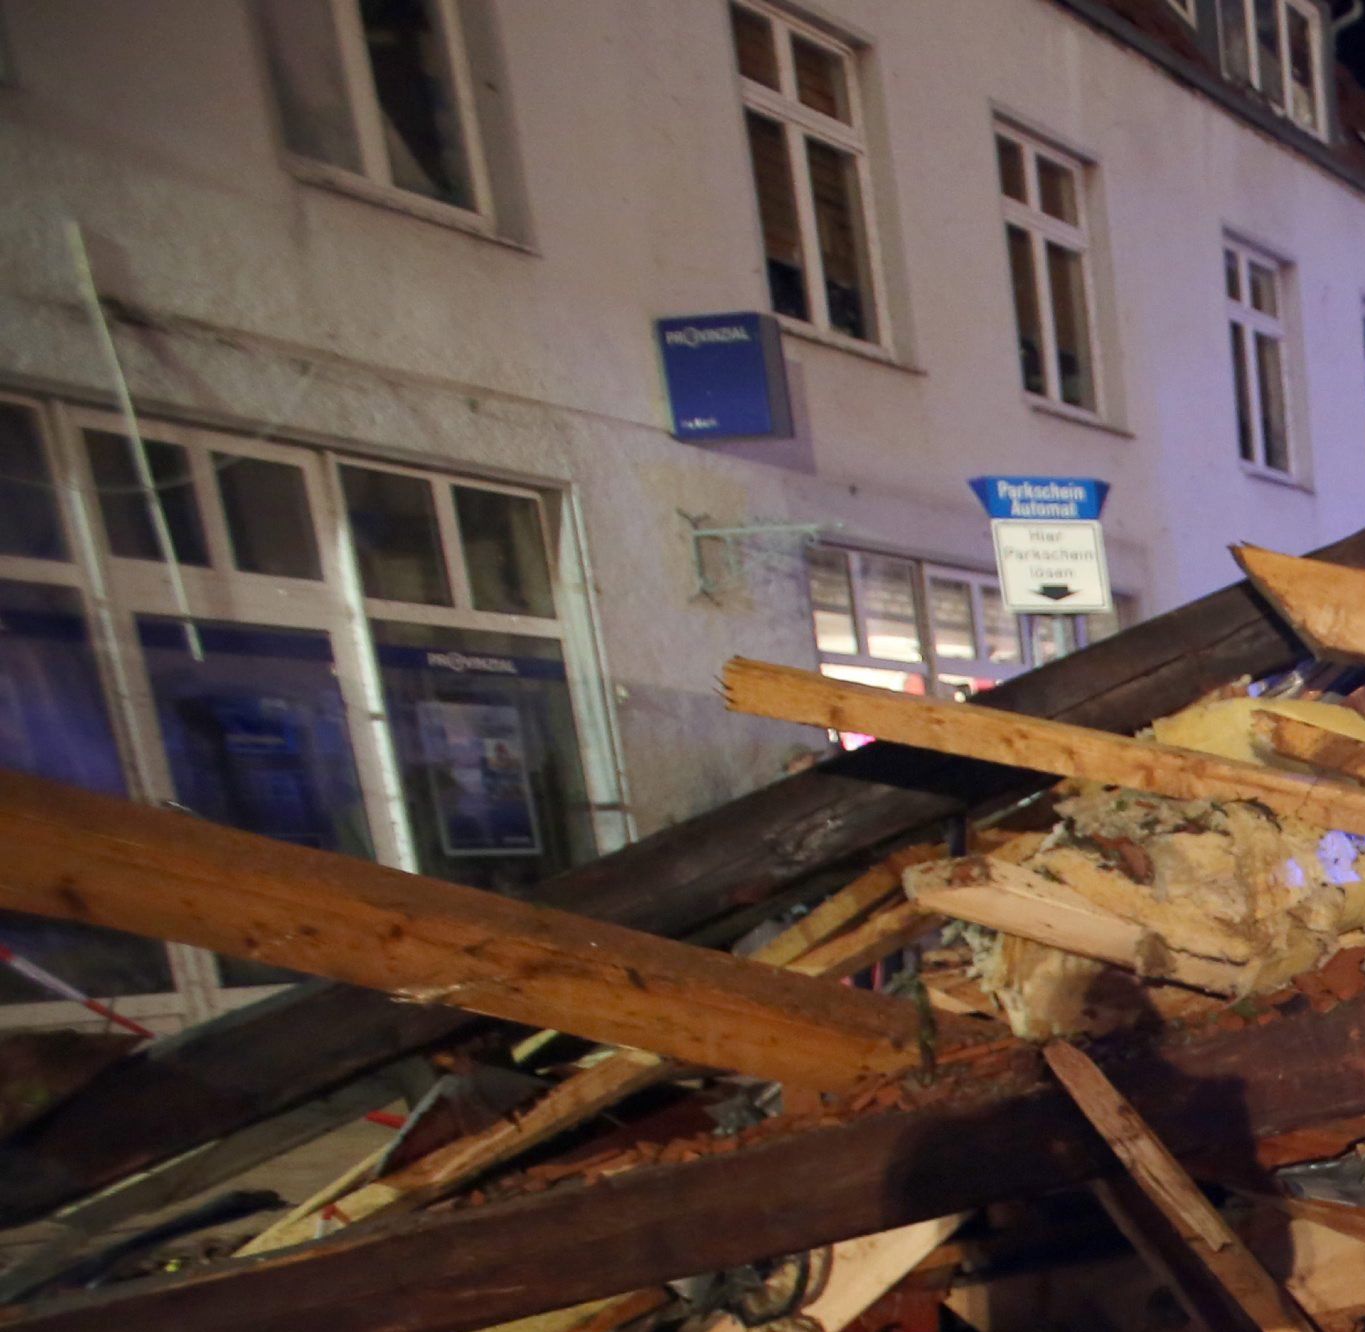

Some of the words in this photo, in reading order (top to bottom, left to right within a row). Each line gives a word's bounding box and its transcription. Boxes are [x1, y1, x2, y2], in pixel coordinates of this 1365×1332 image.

[664, 326, 751, 348] PROVINZIAL
[997, 479, 1086, 501] Parkschein
[1011, 501, 1078, 517] Automat
[1028, 528, 1063, 543] Hier
[1003, 545, 1095, 562] Parkschein
[426, 651, 519, 674] PROVINZIAL
